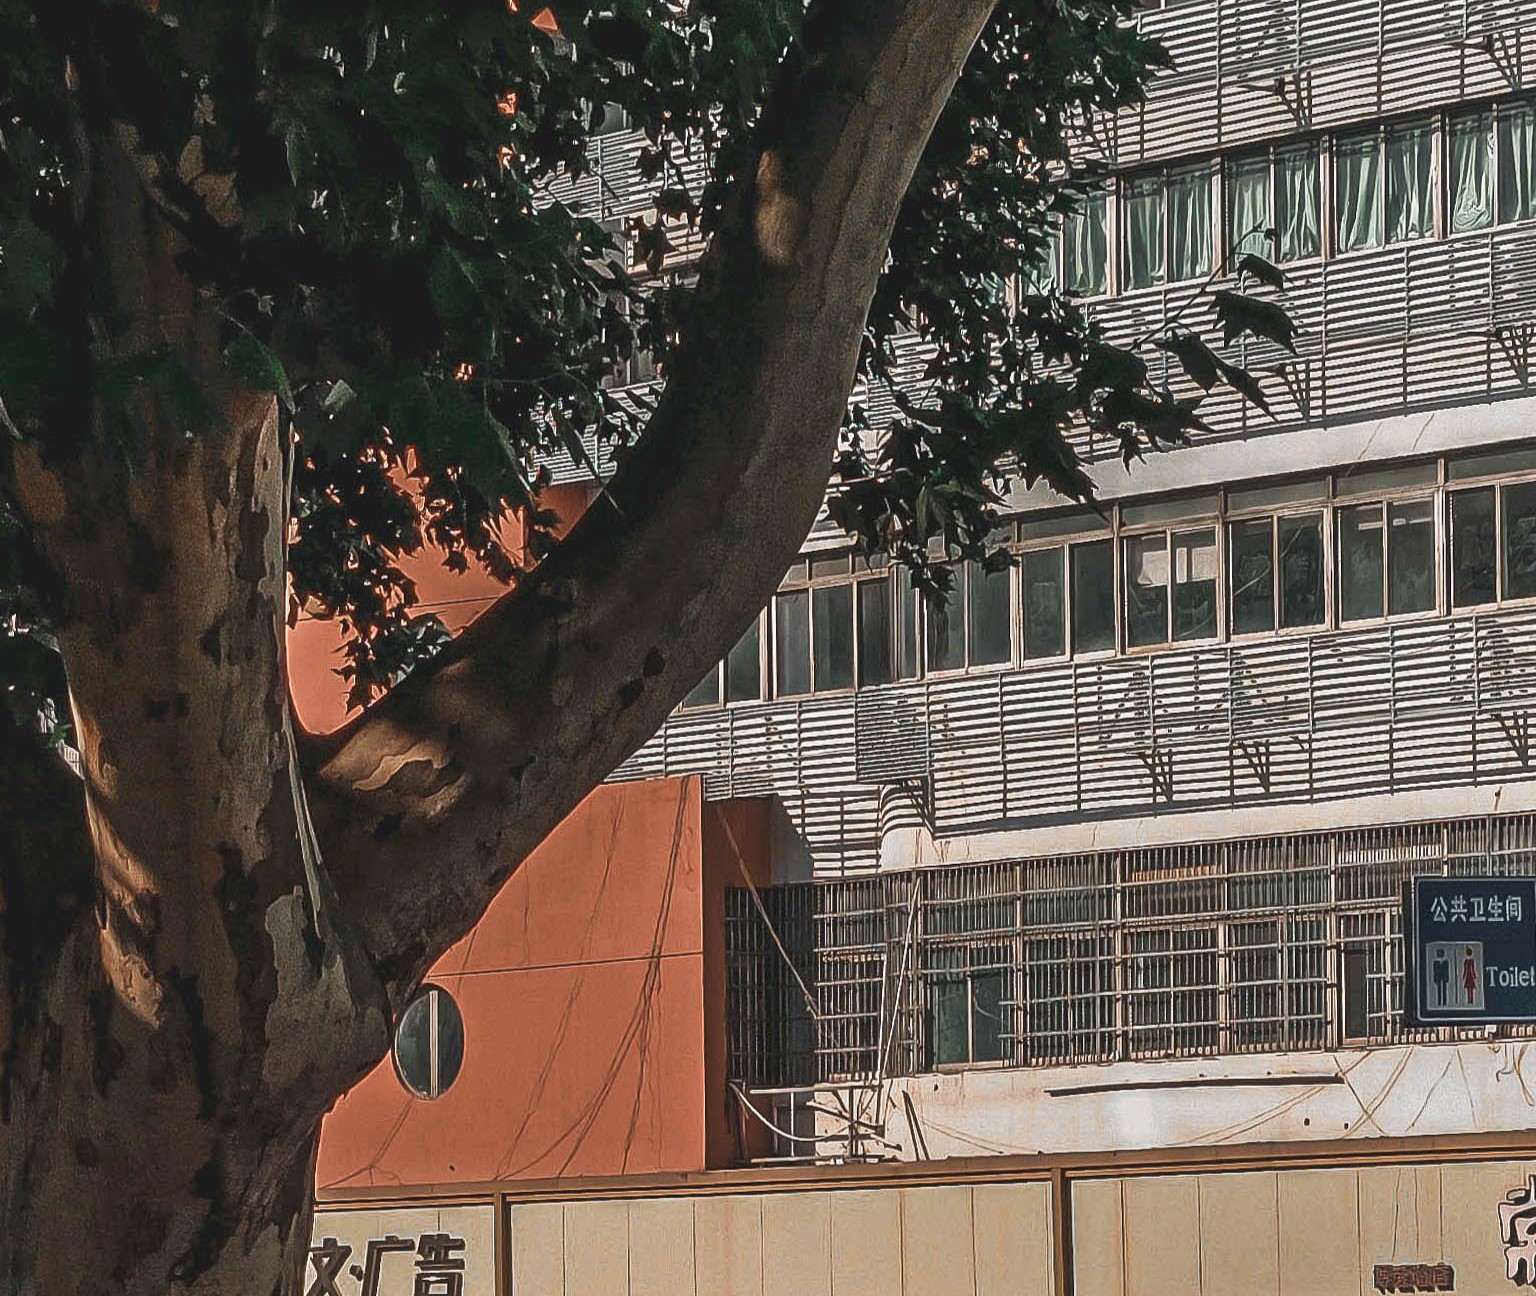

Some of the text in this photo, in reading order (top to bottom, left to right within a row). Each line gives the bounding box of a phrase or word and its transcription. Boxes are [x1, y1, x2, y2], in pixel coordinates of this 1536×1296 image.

[1430, 895, 1522, 922] 公共卫生间
[1486, 966, 1536, 987] Toilet
